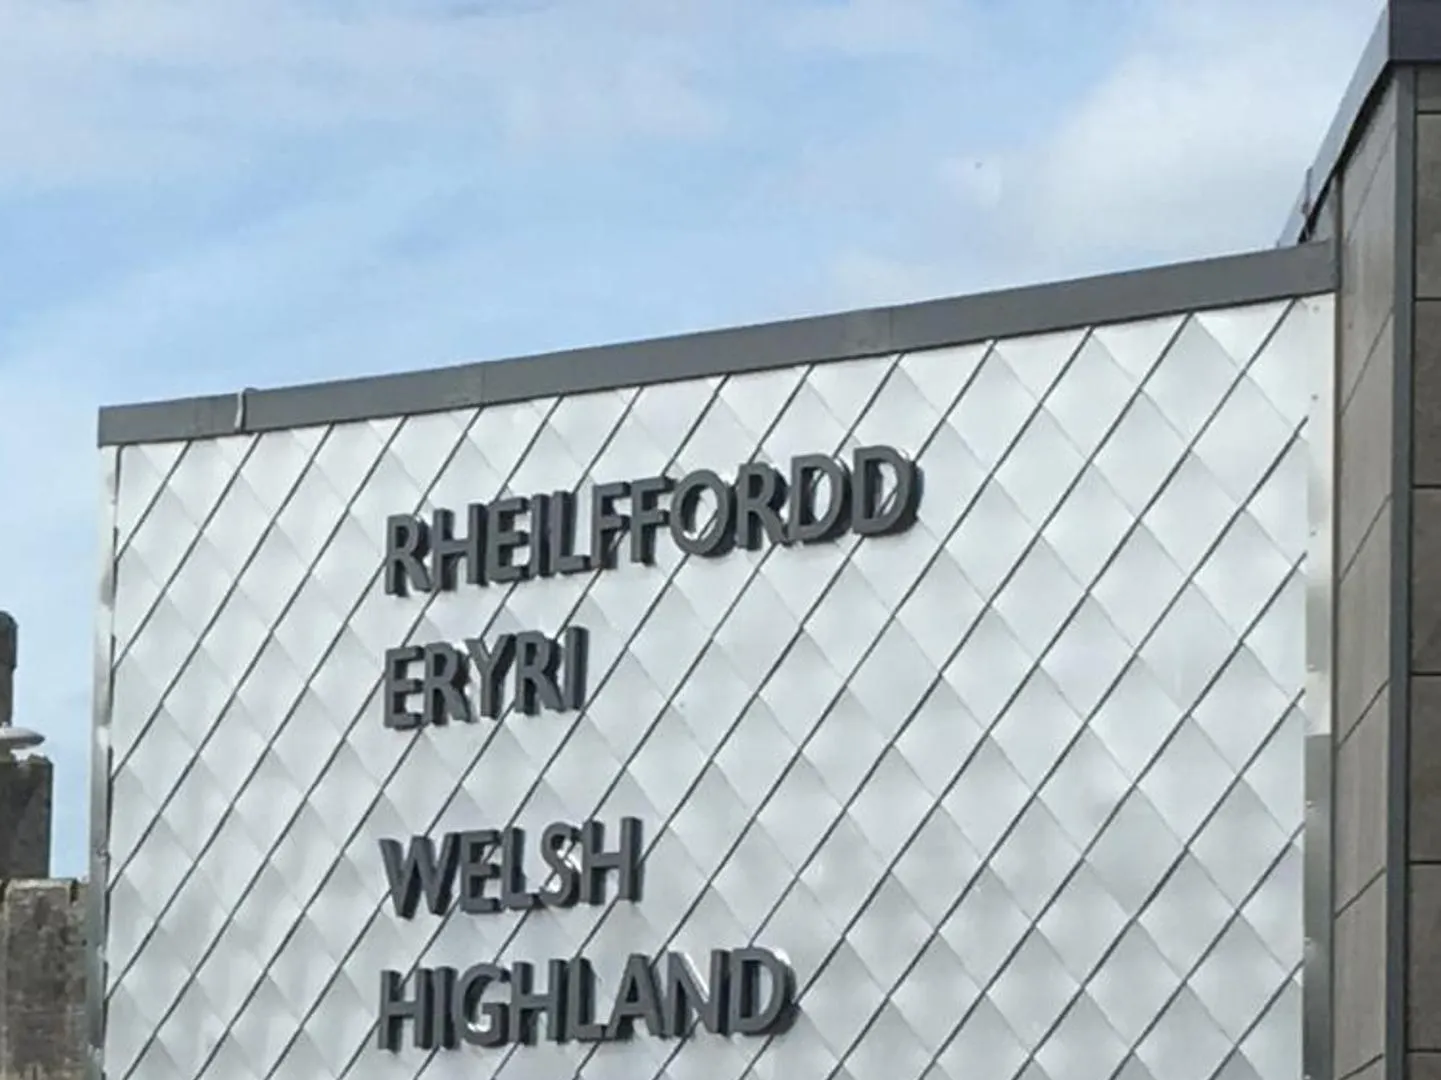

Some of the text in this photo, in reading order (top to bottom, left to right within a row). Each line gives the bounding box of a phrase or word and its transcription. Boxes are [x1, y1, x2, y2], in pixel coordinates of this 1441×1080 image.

[385, 445, 924, 597] RHEILFFORDD
[383, 626, 589, 731] ERYRI
[379, 816, 644, 919] WELSH
[377, 946, 799, 1051] HIGHLAND
